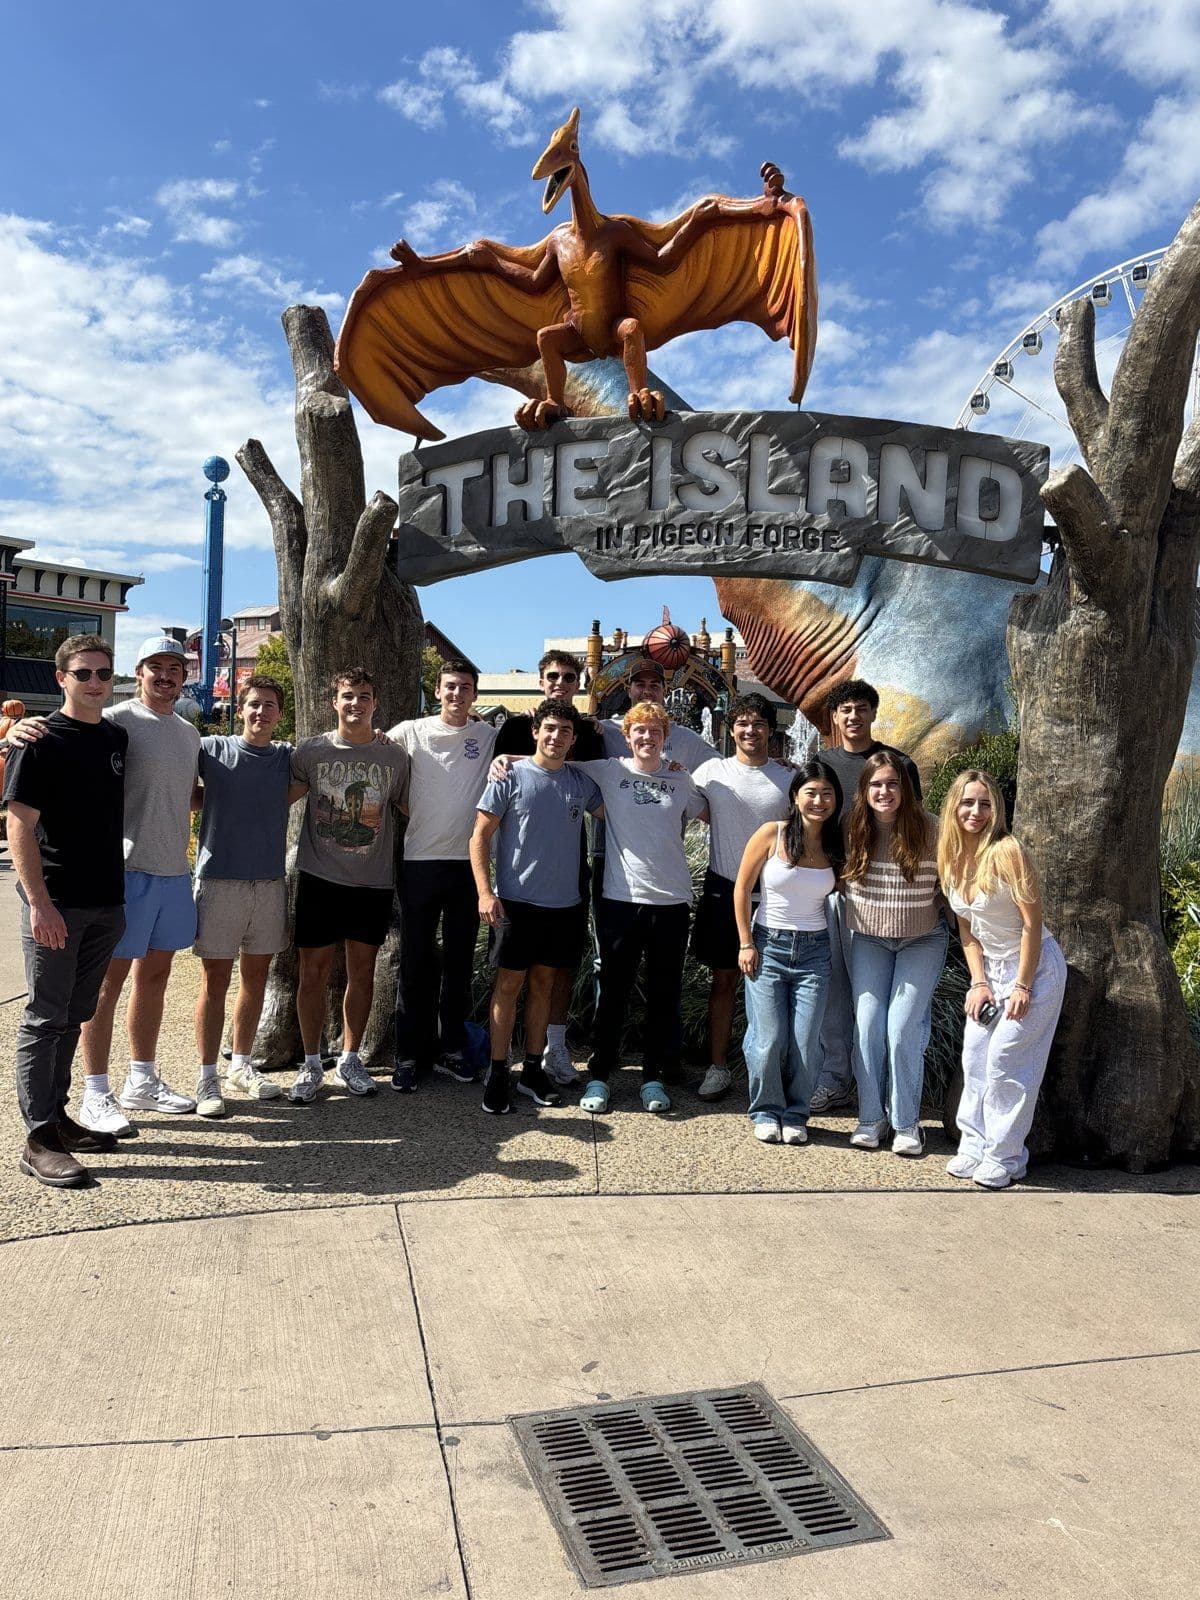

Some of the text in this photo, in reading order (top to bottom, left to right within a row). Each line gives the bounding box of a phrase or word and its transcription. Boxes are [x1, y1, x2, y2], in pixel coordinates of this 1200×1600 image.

[423, 430, 1023, 542] THE ISLAND
[596, 521, 842, 553] IN PIGEON FORGE
[752, 1538, 809, 1557] GENERAL
